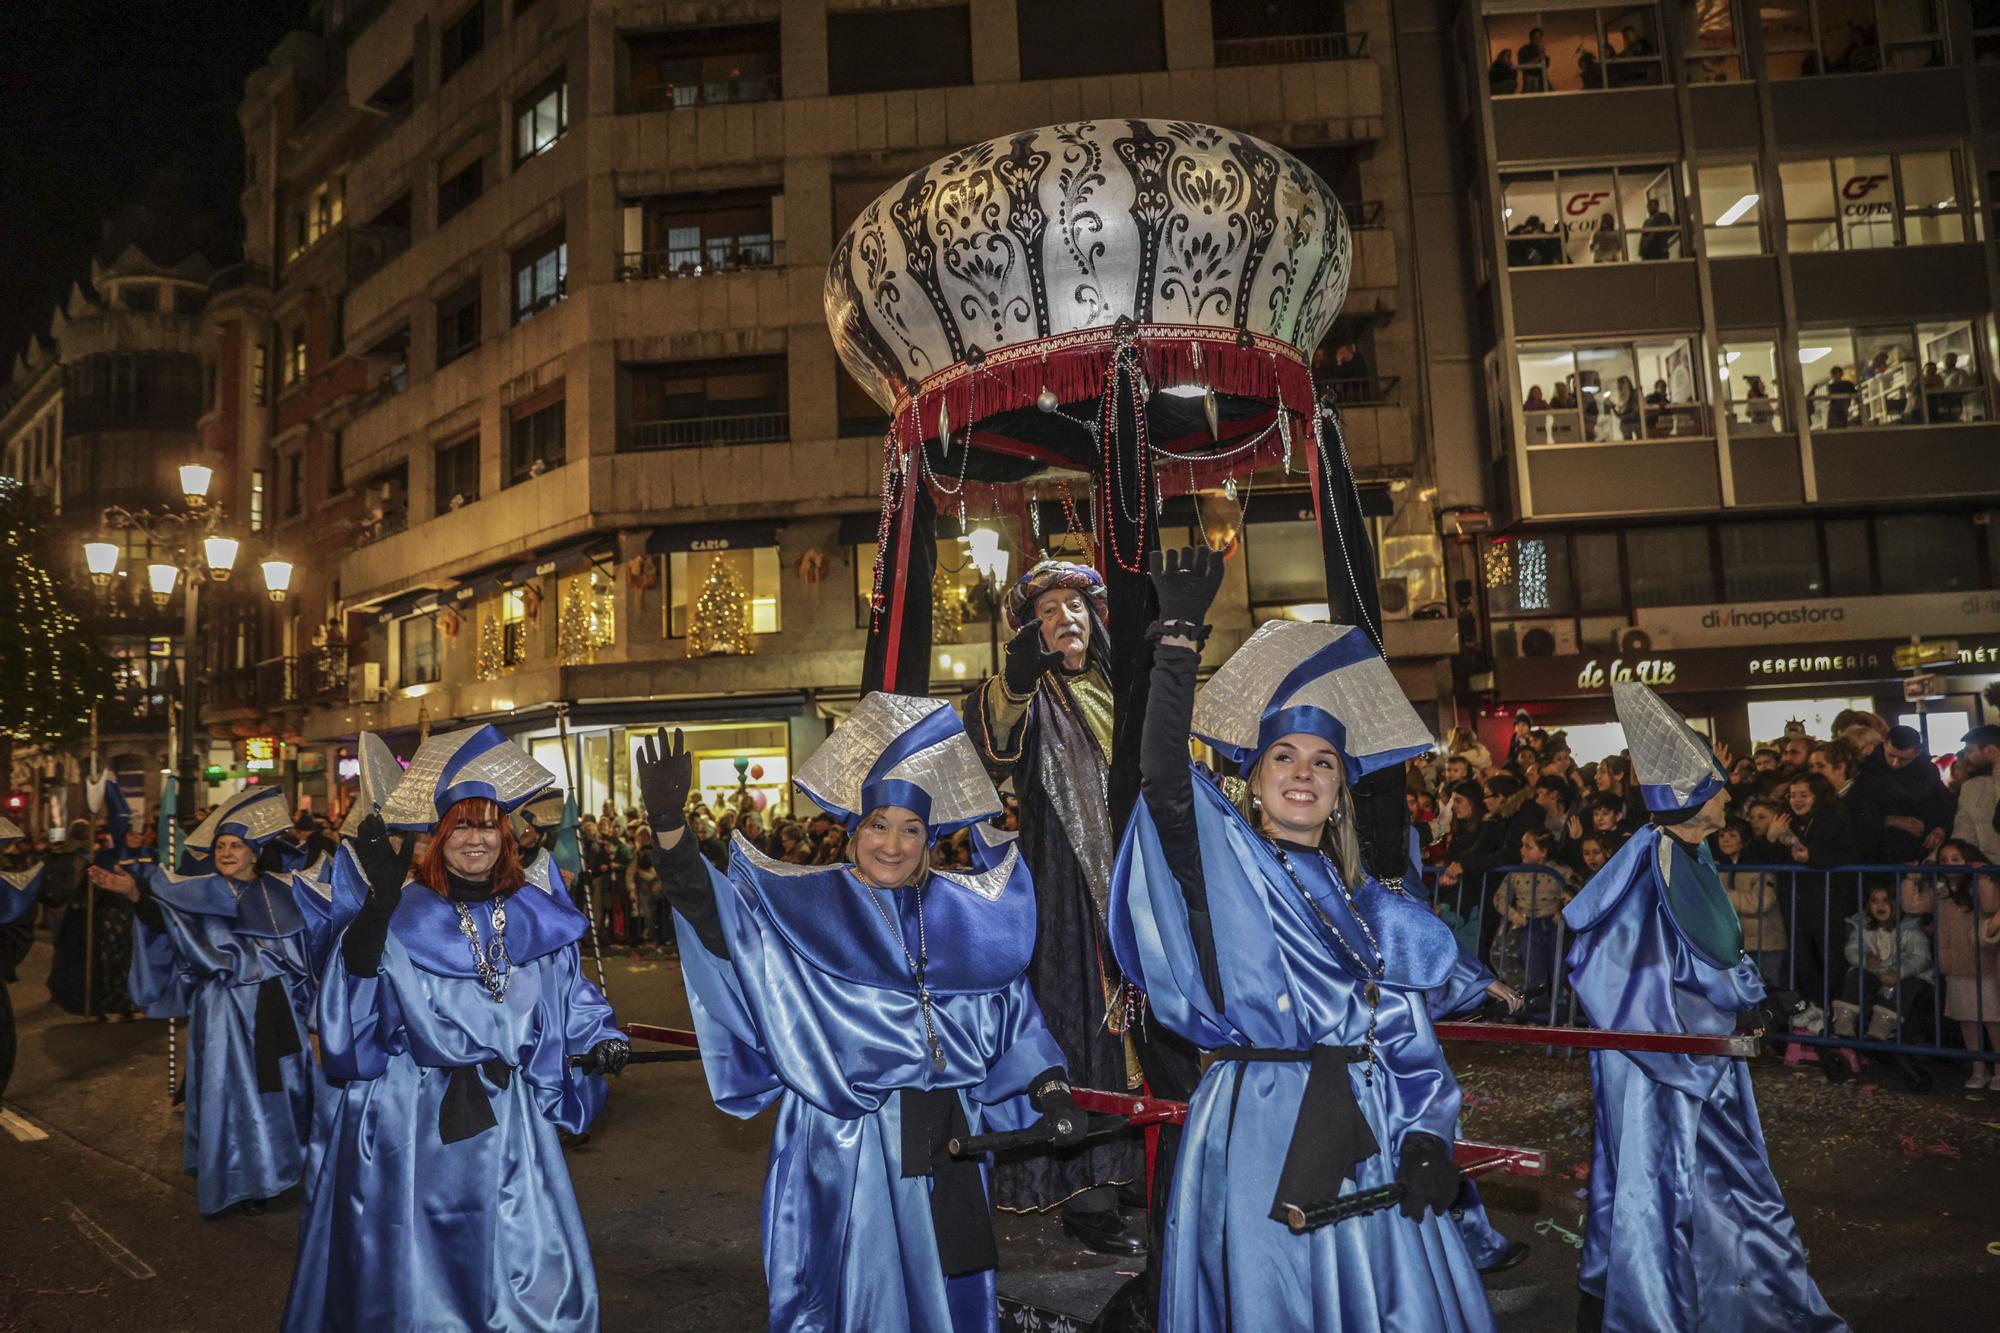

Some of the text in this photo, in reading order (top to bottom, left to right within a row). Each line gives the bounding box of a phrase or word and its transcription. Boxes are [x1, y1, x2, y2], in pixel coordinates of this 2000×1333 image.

[1842, 174, 1889, 200] GF
[1566, 191, 1610, 216] GF
[1701, 605, 1845, 629] divinapastora
[1577, 659, 1605, 689] de
[1610, 659, 1633, 687] la
